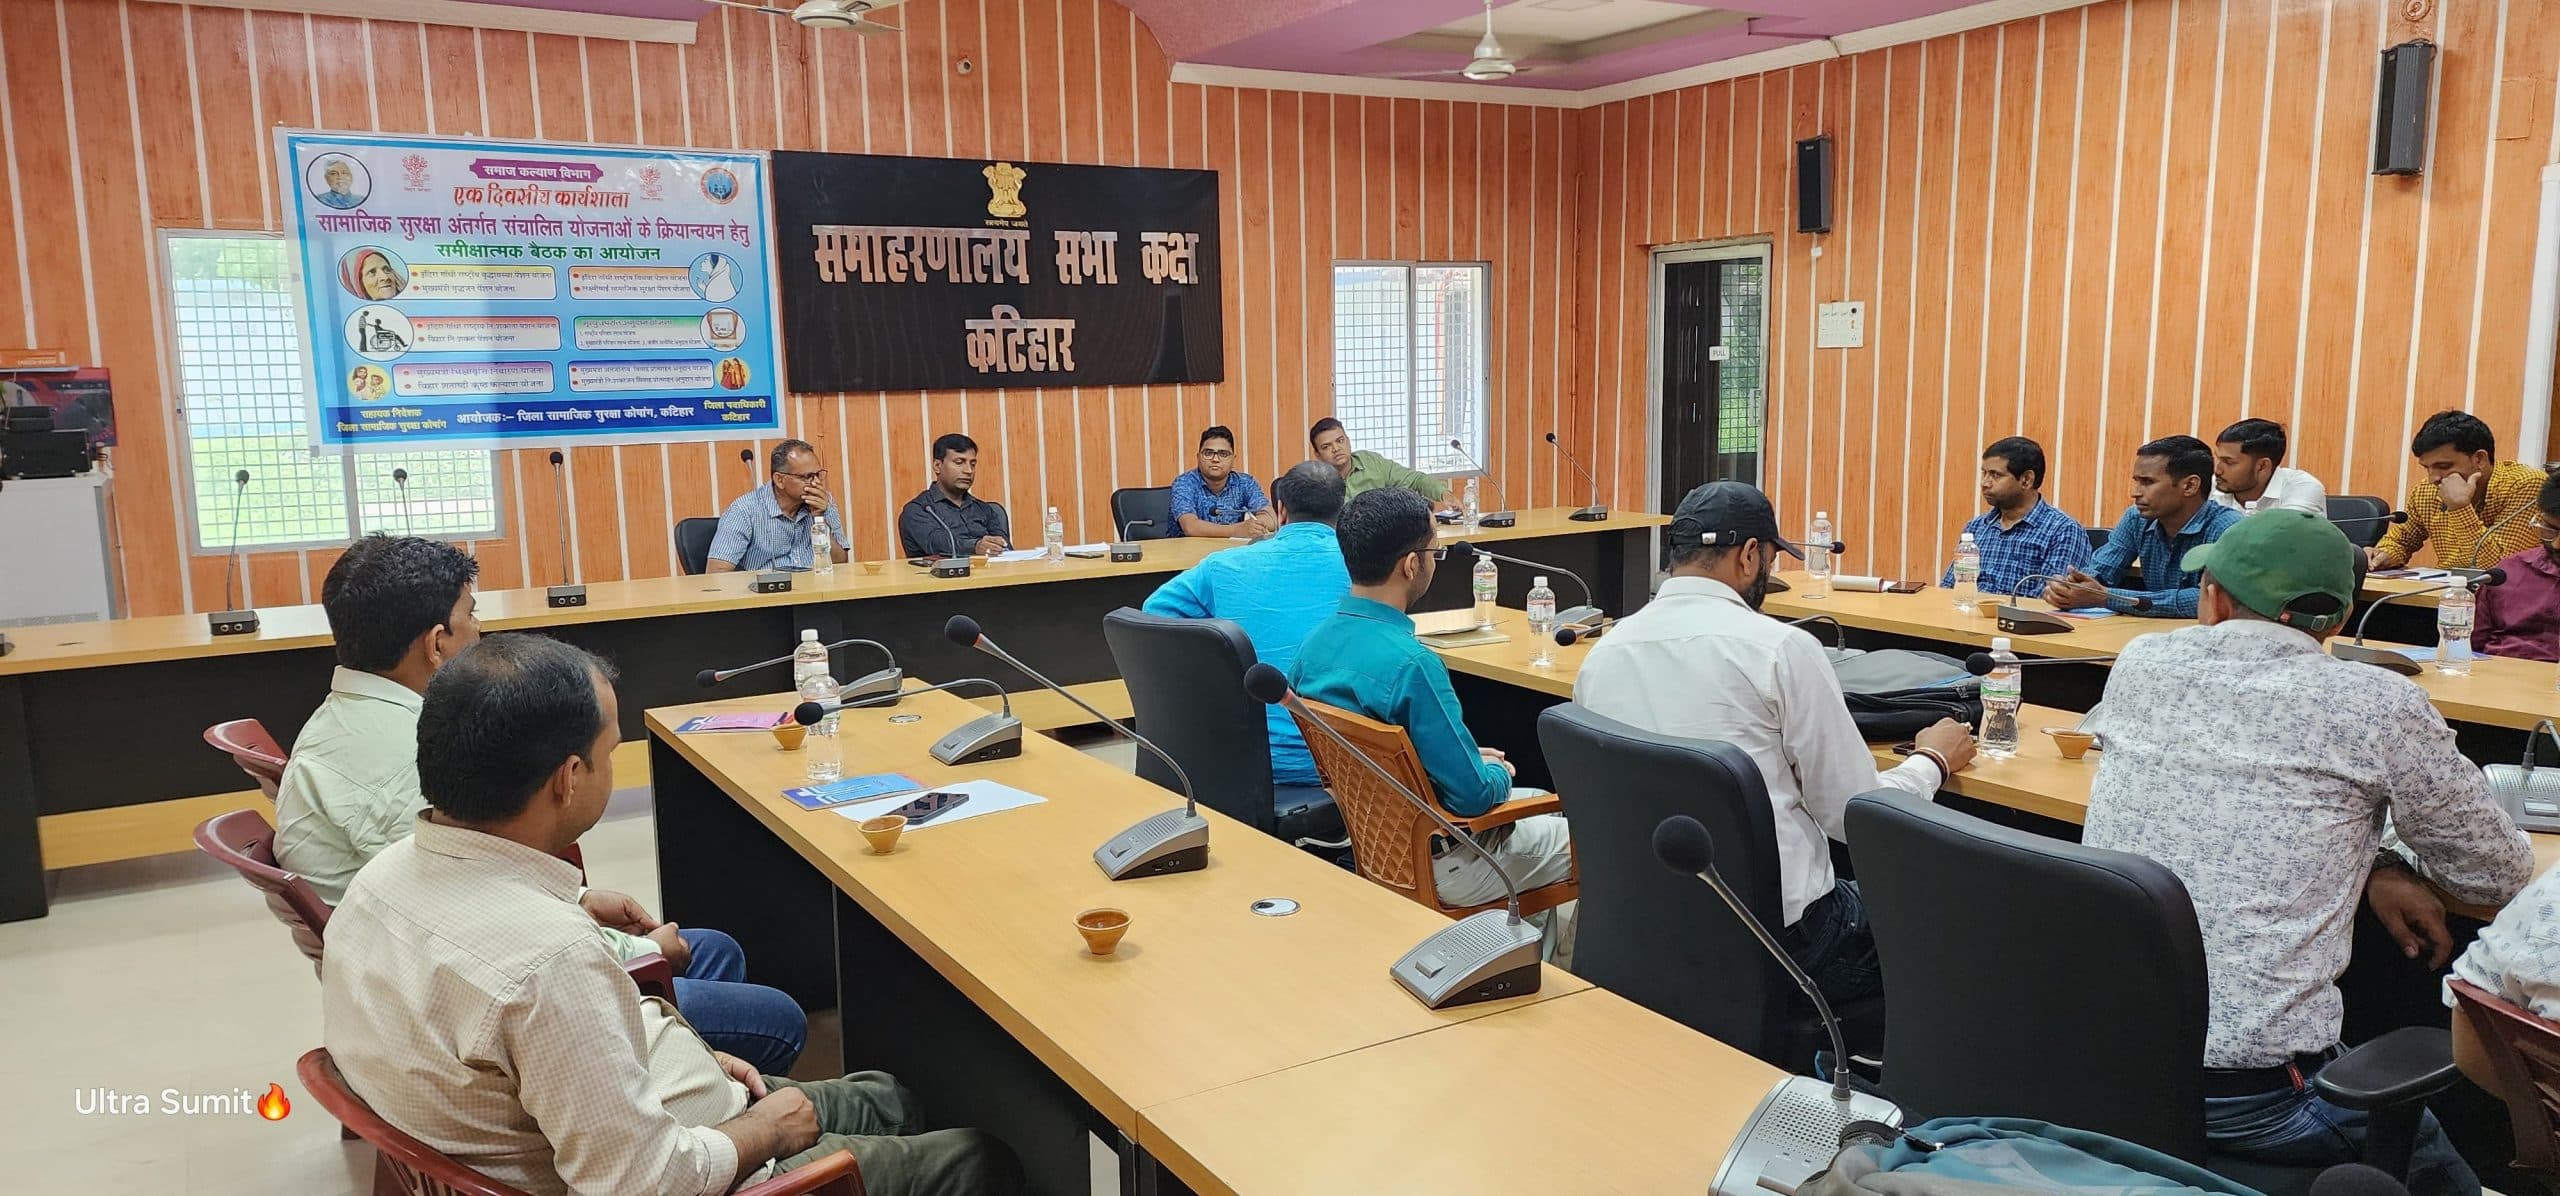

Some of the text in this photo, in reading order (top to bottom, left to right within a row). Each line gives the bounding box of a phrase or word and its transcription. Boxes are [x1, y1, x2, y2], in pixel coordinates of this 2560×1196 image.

[483, 165, 591, 179] समाज कल्याण विभाग
[453, 183, 631, 208] एक दिवसीय कार्यशाला
[316, 209, 750, 247] सामाजिक सुरक्षा अंतर्गत संचालित योजनाओं के क्रियान्वयन हेतु
[435, 239, 661, 260] समीक्षात्मक बैठक का आयोजन
[811, 224, 1200, 285] समाहरणालय सभा कक्ष
[964, 304, 1076, 373] कटिहार
[517, 409, 543, 422] जिला
[547, 408, 592, 421] सामाजिक
[595, 407, 621, 423] सुरक्षा
[660, 405, 695, 417] कटिहार
[721, 411, 751, 422] कटिहार
